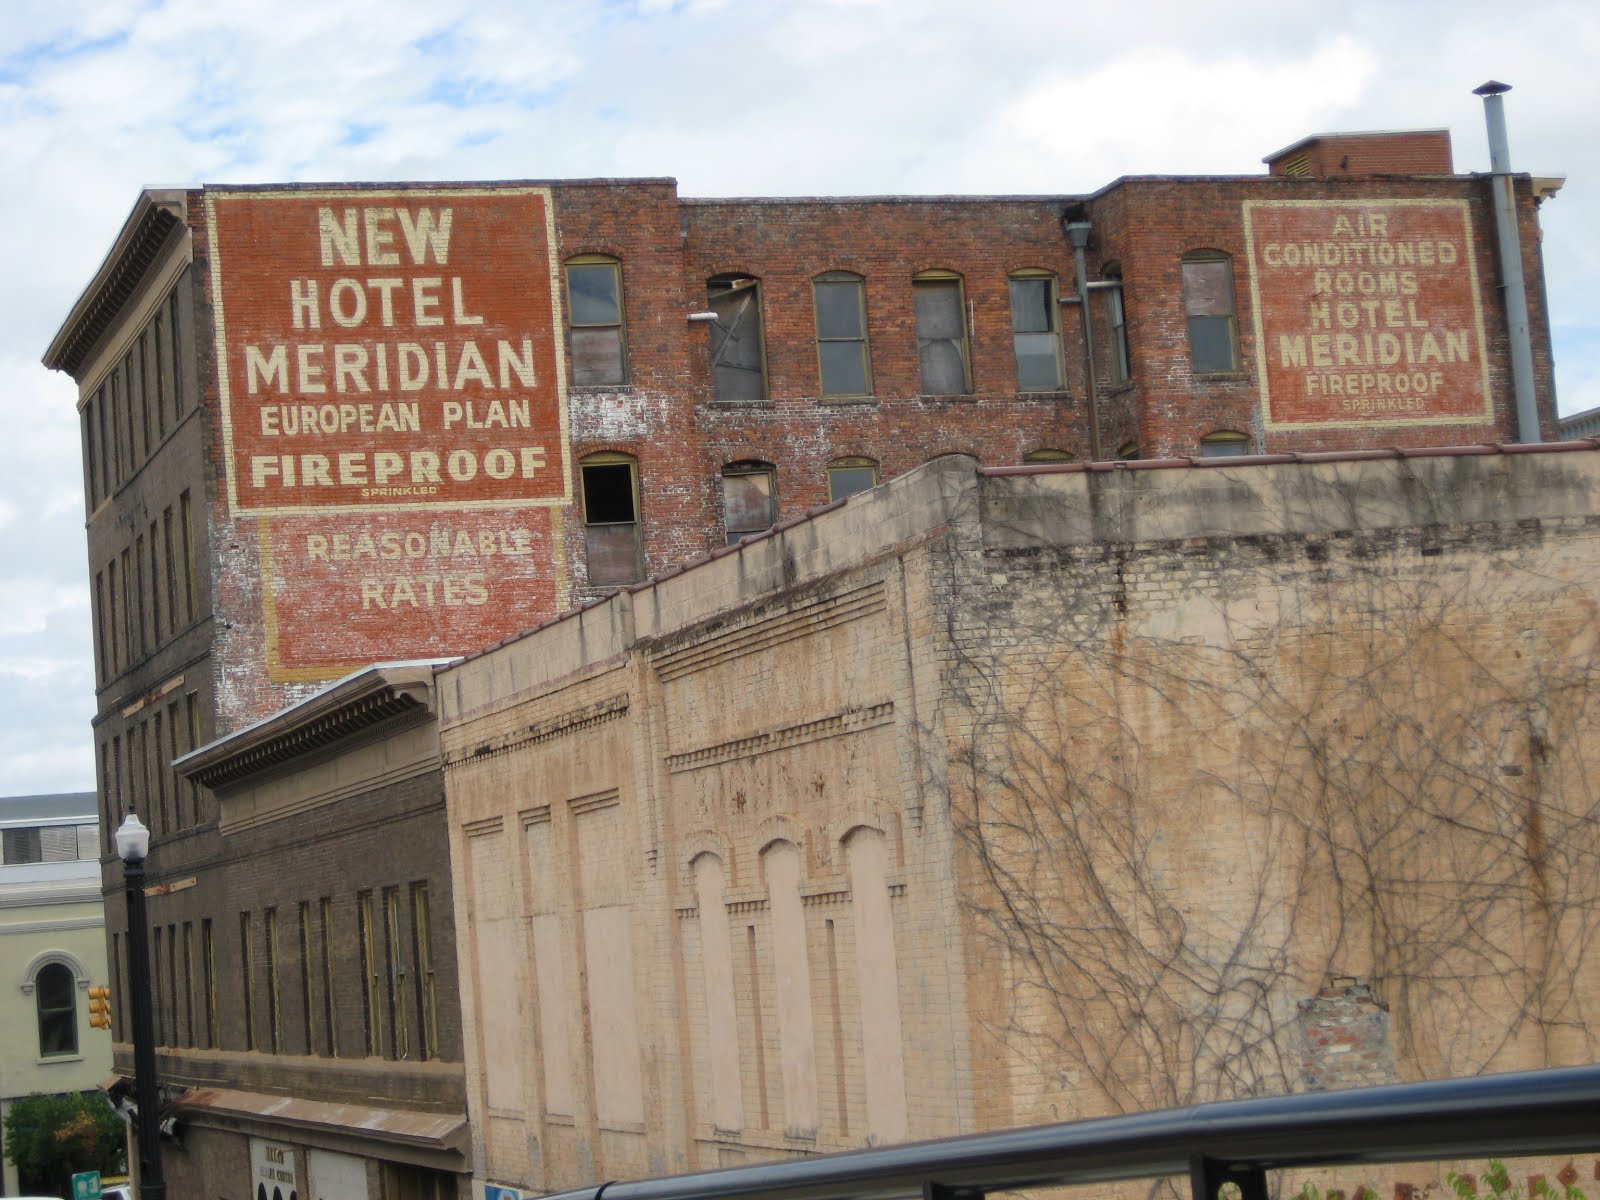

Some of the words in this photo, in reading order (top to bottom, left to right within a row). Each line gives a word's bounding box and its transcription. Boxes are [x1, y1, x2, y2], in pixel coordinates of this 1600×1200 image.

[318, 207, 452, 266] NEW
[1333, 213, 1388, 237] AIR
[1263, 241, 1457, 267] CONDITIONED
[1314, 271, 1419, 296] ROOMS
[290, 277, 484, 329] HOTEL
[1310, 300, 1429, 329] HOTEL
[1279, 329, 1470, 368] MERIDIAN
[245, 339, 538, 394] MERIDIAN
[1306, 371, 1443, 396] FIREPROOF
[260, 402, 421, 436] EUROPEAN
[443, 400, 531, 430] PLAN
[1342, 397, 1425, 412] SPRINKLED
[251, 447, 547, 488] FIREPROOF
[361, 486, 437, 497] SPRINKLED
[306, 528, 535, 562] REASONABLE
[361, 574, 489, 610] RATES
